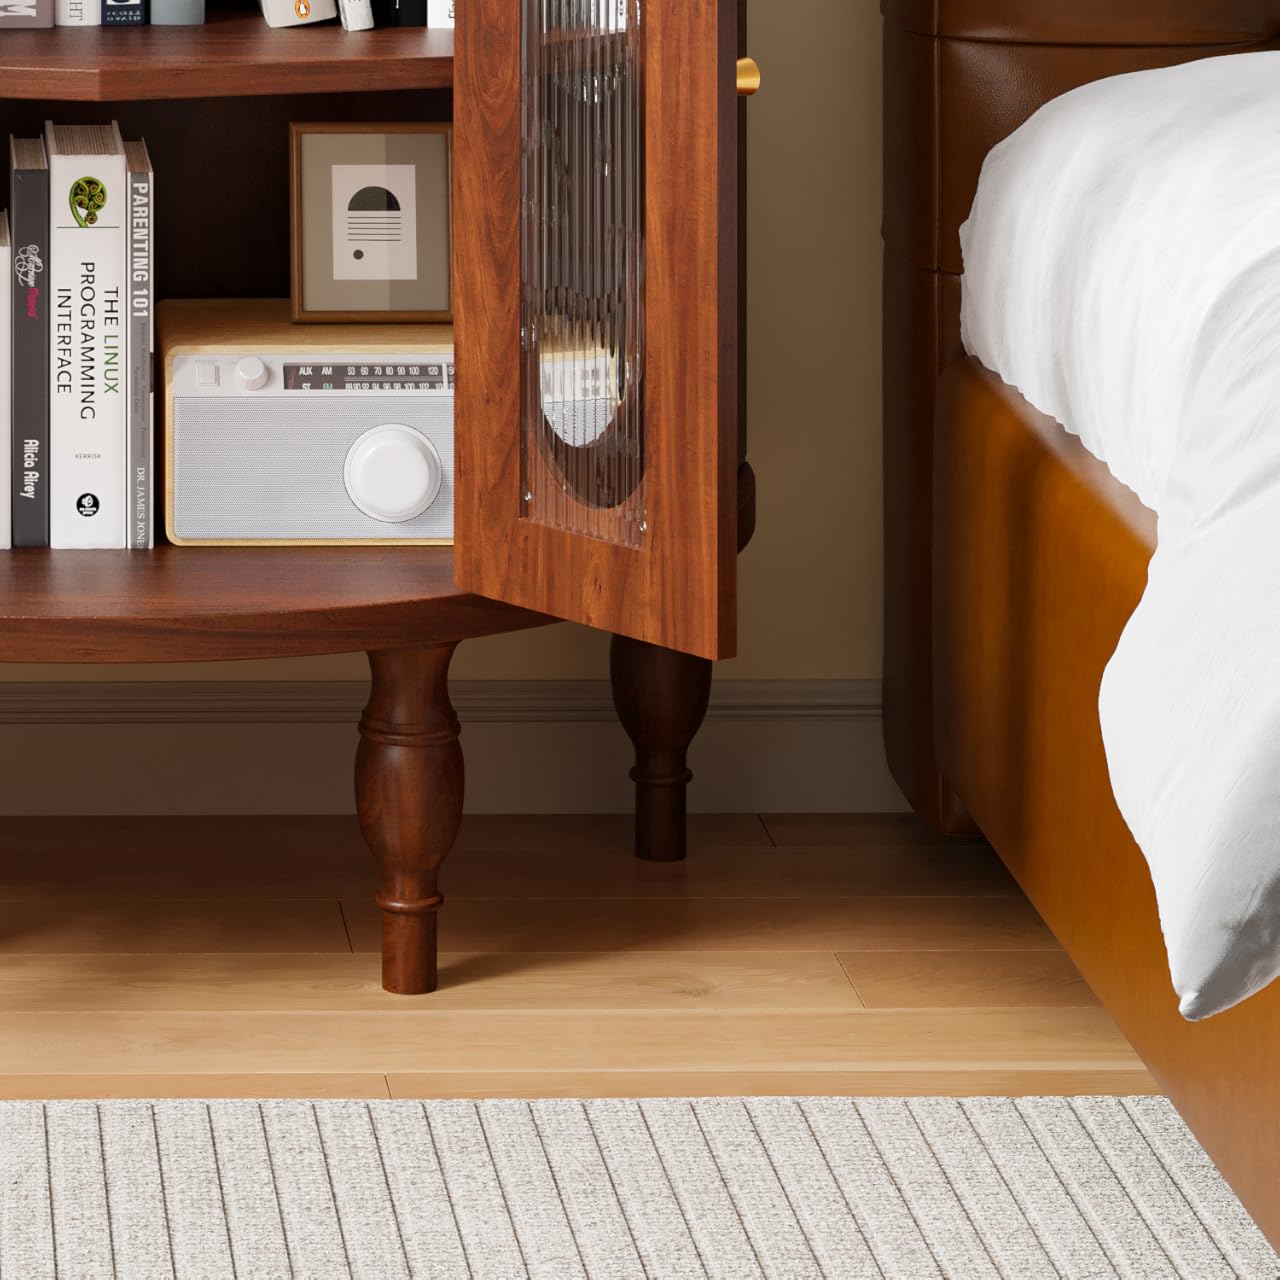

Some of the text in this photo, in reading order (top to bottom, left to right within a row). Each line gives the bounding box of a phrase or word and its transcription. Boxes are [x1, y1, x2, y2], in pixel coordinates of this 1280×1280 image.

[132, 182, 149, 282] PARENTING
[56, 288, 72, 394] INTERFACE
[80, 261, 96, 420] PROGRAMMING
[103, 286, 119, 394] THE LINUX
[132, 287, 149, 318] 101
[299, 366, 313, 375] AUX
[321, 366, 333, 375] AM
[360, 366, 369, 375] 60
[374, 366, 382, 375] 70
[385, 366, 394, 375] 80
[397, 366, 405, 375] 90
[409, 366, 420, 375] 100
[427, 366, 439, 375] 120
[19, 439, 39, 499] Alicia Airey
[136, 485, 146, 519] JAMES
